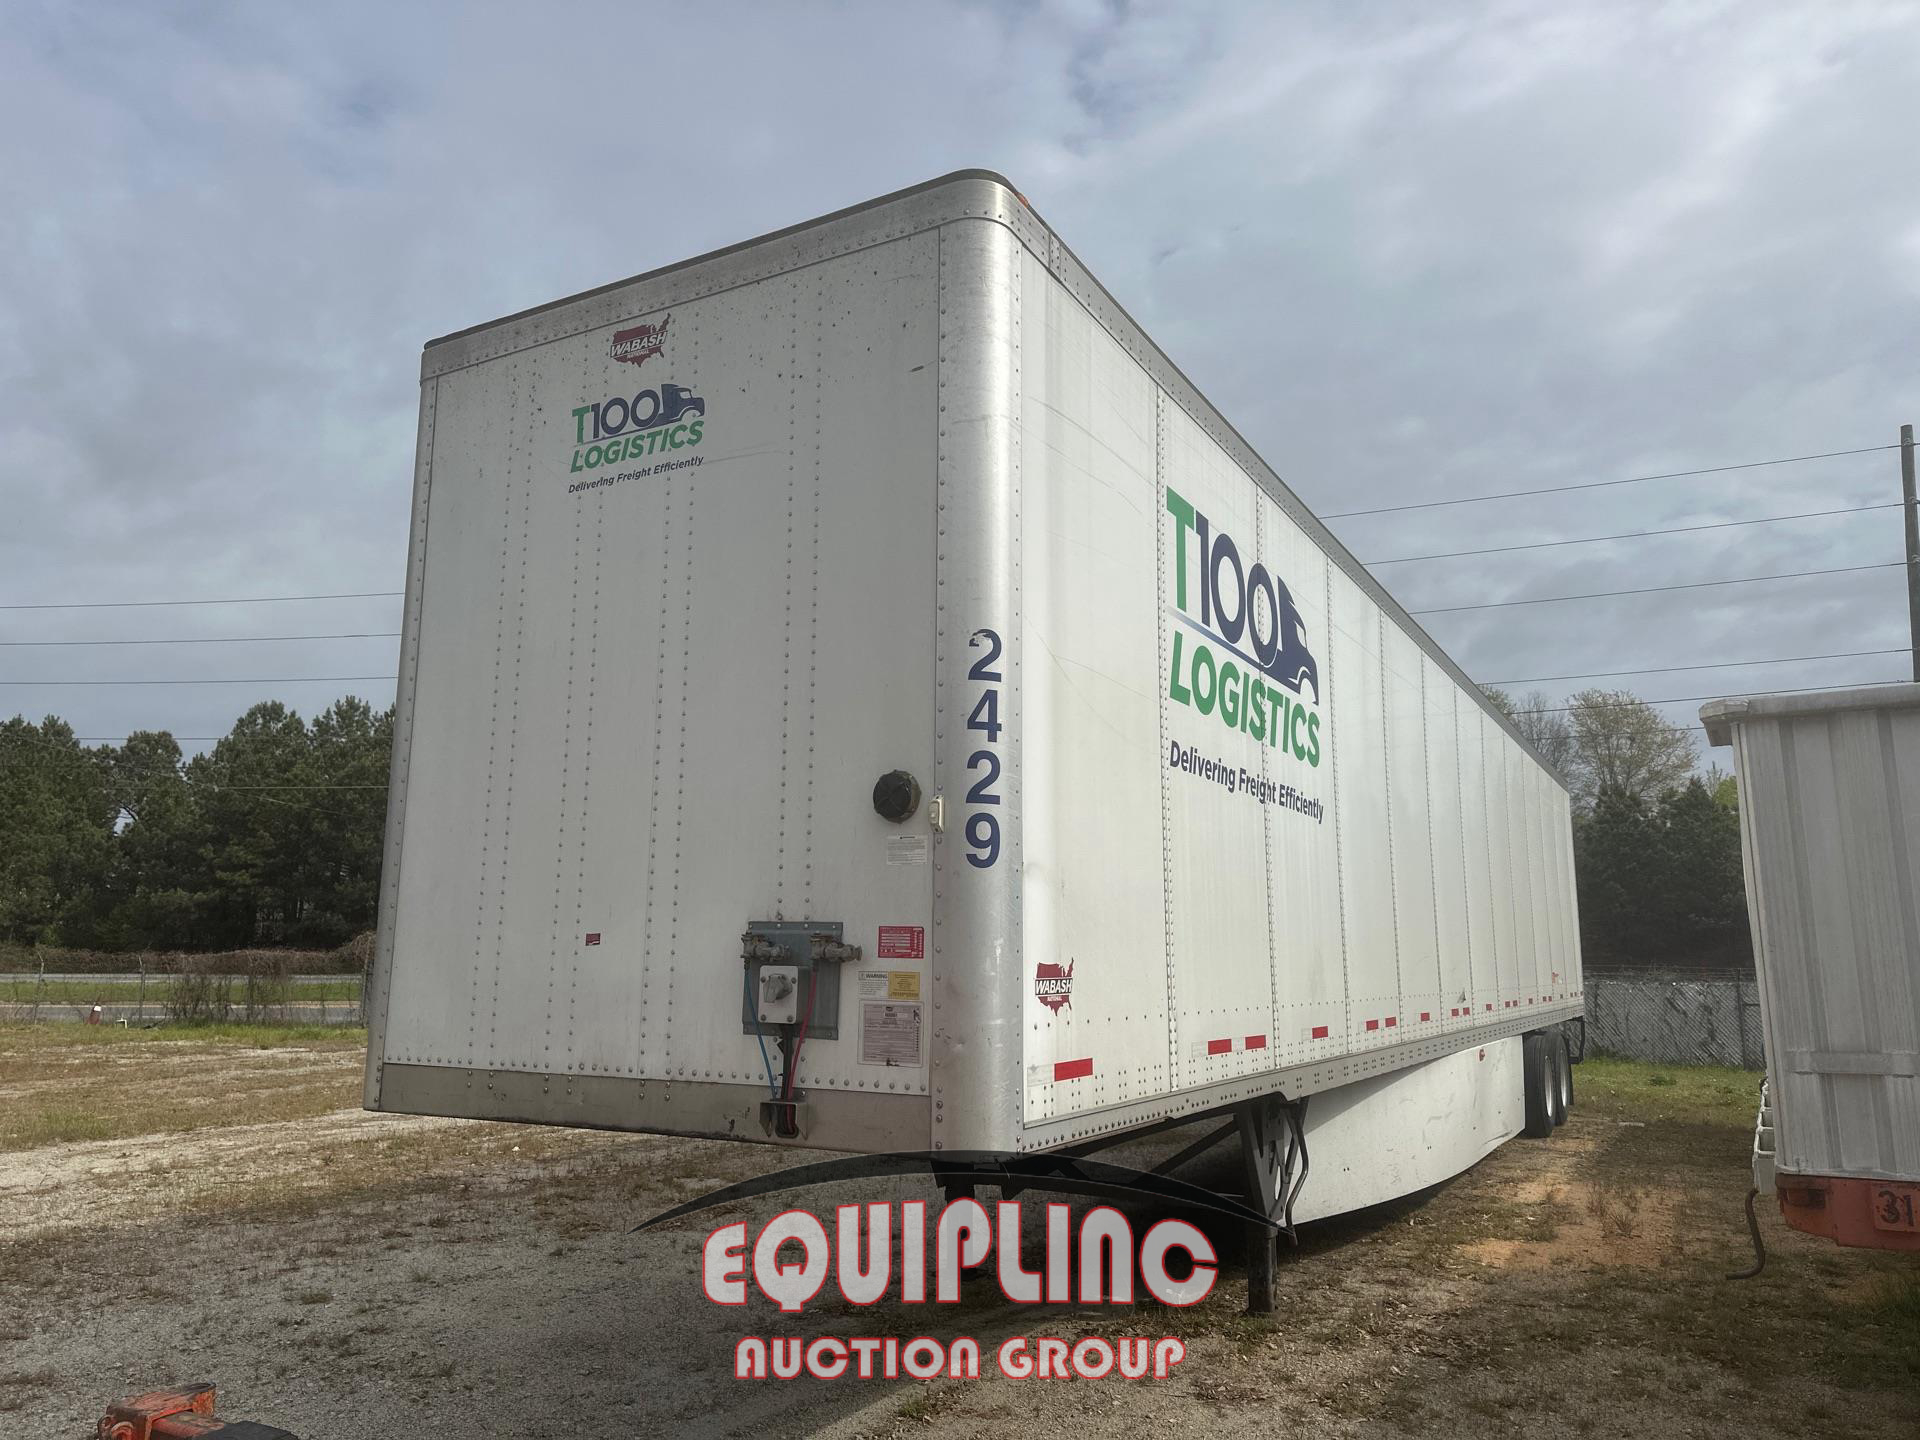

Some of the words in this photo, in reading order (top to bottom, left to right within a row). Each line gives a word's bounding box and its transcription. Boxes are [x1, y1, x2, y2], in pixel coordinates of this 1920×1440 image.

[611, 331, 667, 357] WABASH
[572, 389, 660, 443] T100
[570, 420, 705, 473] LOGISTICS
[568, 476, 614, 493] Delivering
[616, 467, 652, 483] Freight
[653, 455, 704, 475] Efficiently
[1166, 485, 1278, 668] T100
[1169, 630, 1320, 768] LOGISTICS
[965, 628, 1002, 868] 2429
[1169, 740, 1236, 793] Delivering
[1238, 767, 1277, 804] Freight
[1278, 783, 1324, 825] Efficiently
[1035, 979, 1072, 995] WABASH
[1878, 1190, 1914, 1227] 31
